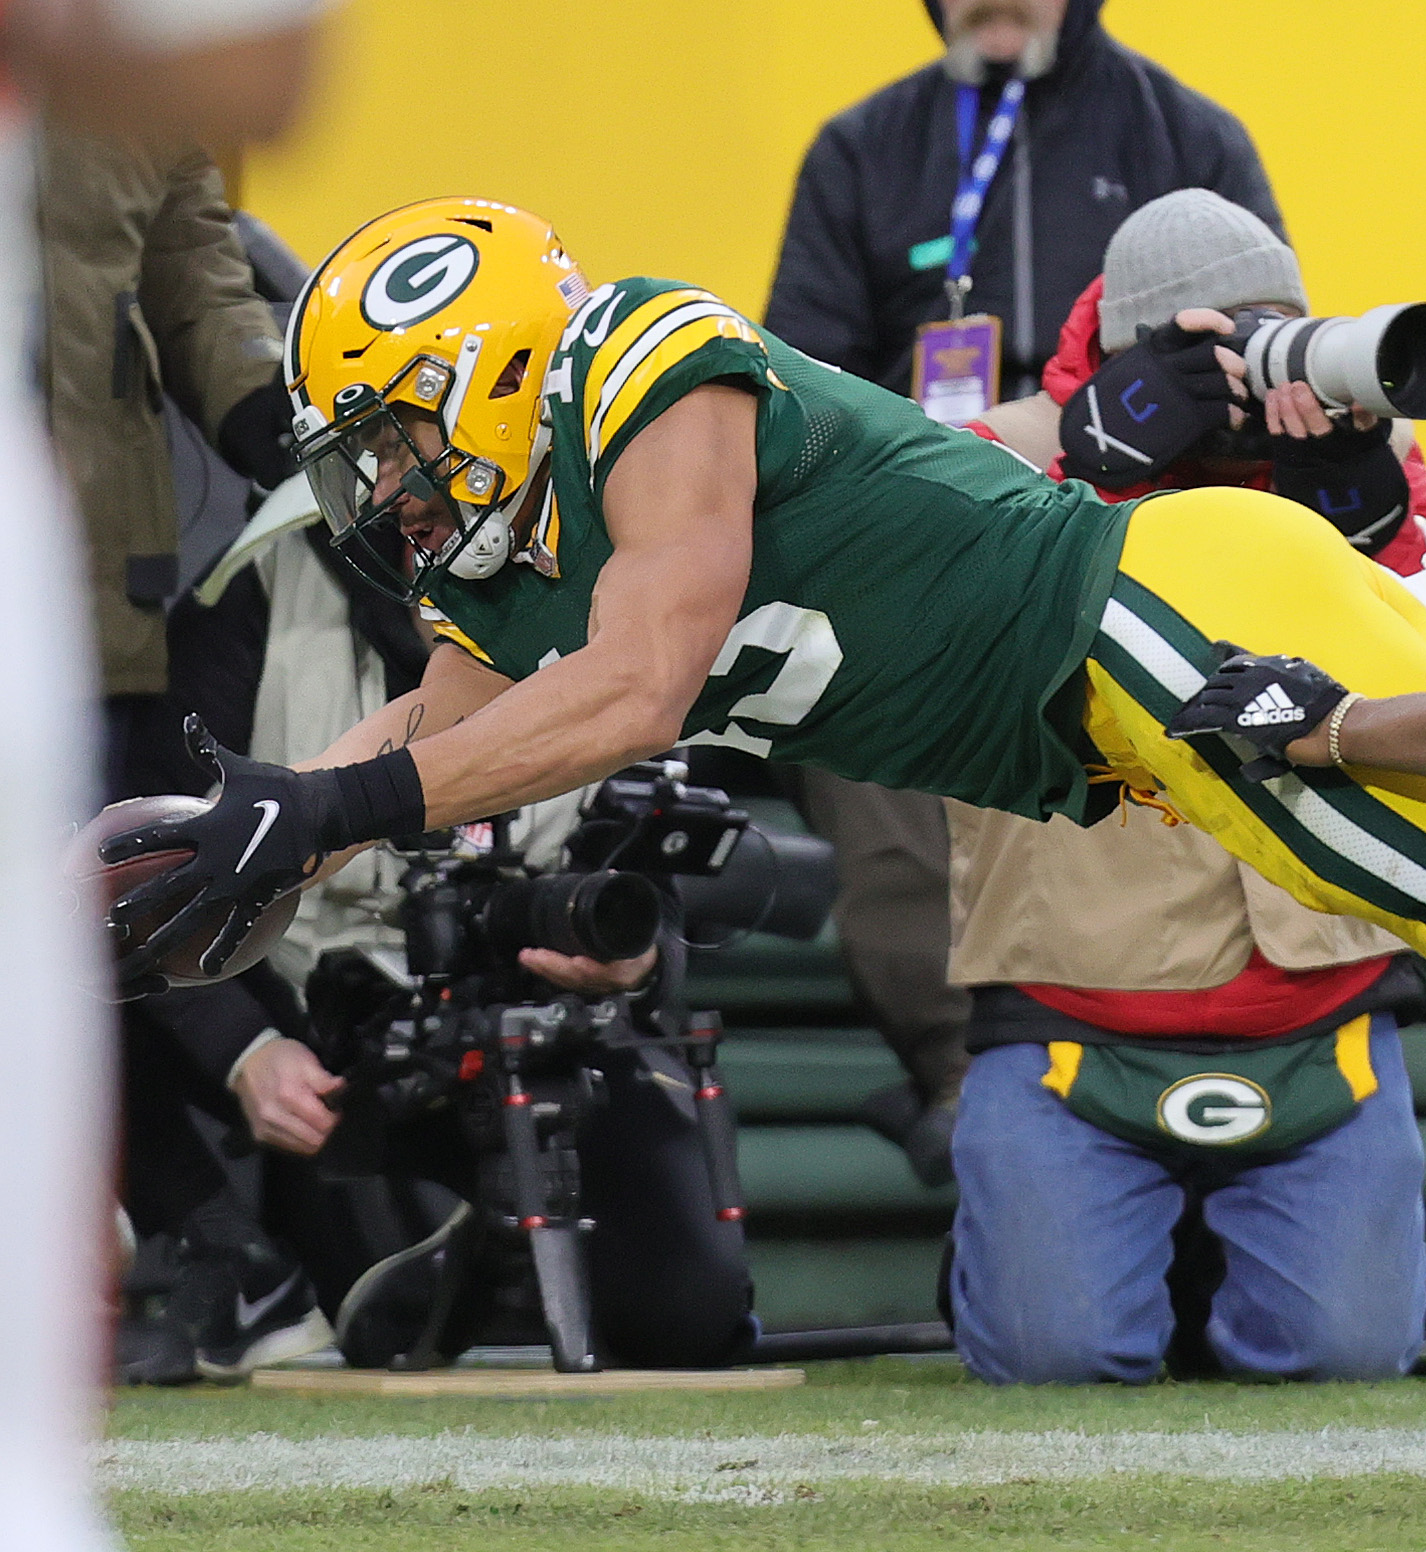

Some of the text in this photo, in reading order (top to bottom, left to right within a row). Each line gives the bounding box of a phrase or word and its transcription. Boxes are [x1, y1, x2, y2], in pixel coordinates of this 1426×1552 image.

[361, 234, 478, 330] G
[1237, 705, 1306, 727] adidas
[1158, 1073, 1270, 1145] G
